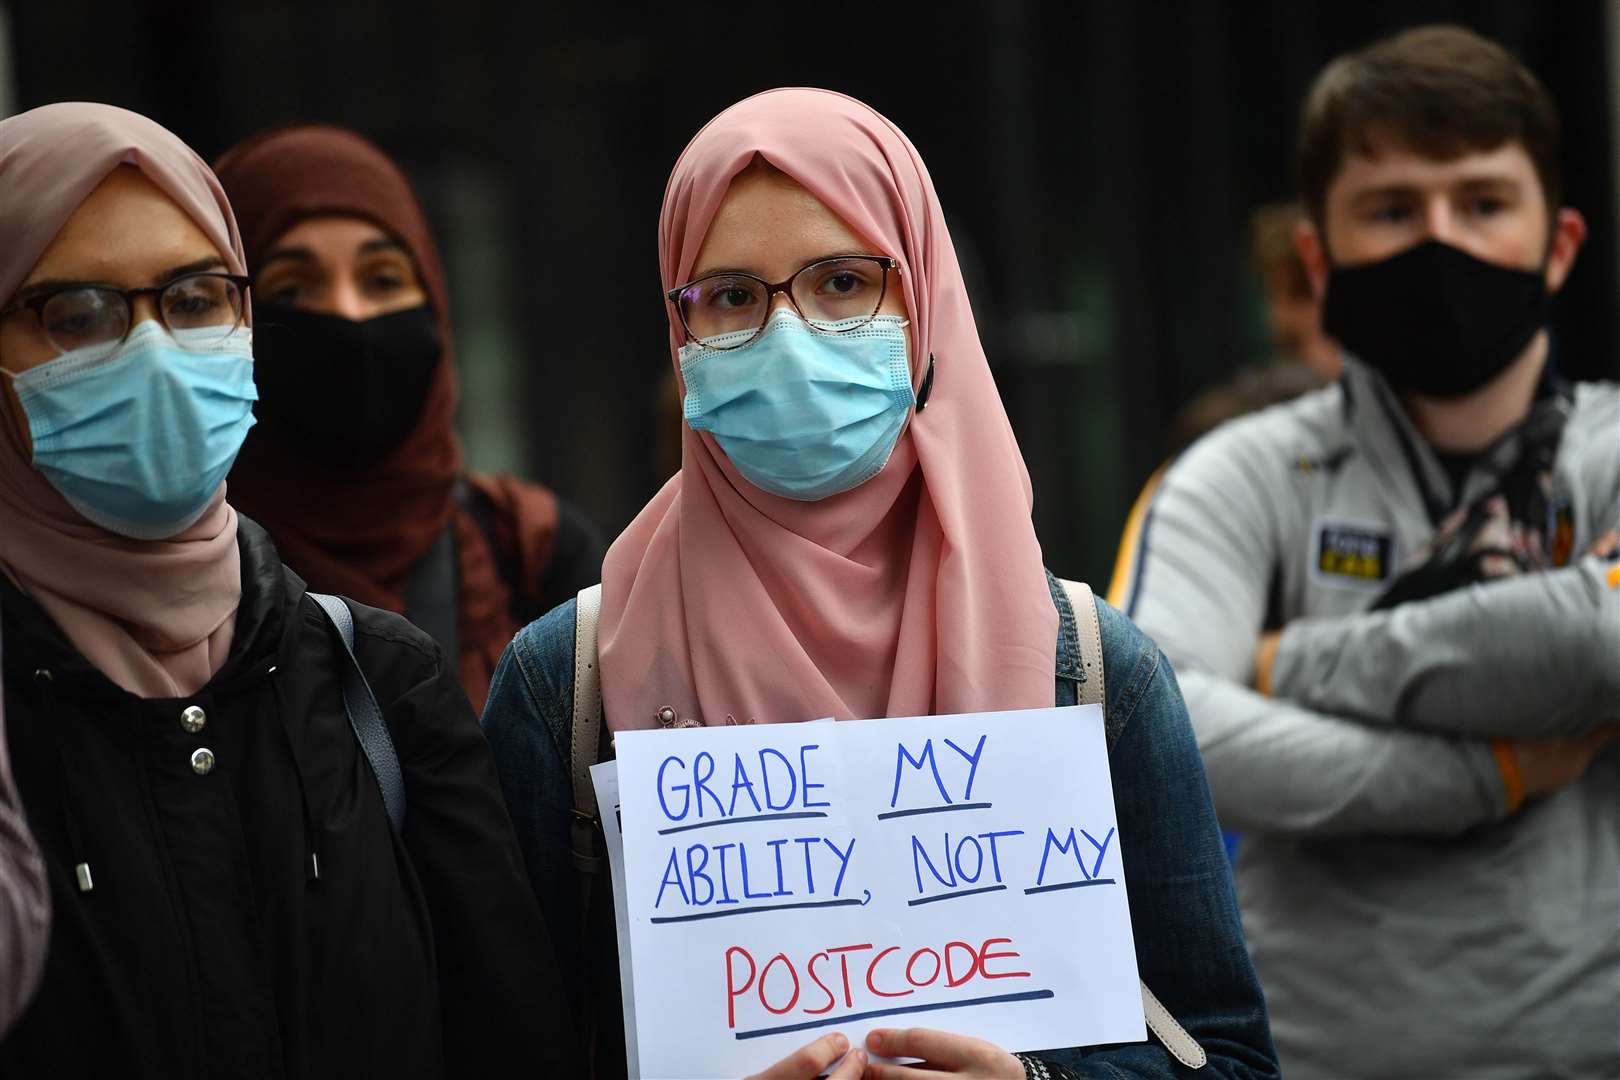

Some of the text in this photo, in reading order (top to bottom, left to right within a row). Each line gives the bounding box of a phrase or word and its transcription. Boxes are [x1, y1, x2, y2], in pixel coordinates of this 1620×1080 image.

[656, 744, 831, 822] GRADE
[890, 734, 987, 808] MY
[654, 826, 1116, 909] ABILITY, NOT MY
[725, 936, 1031, 1029] POSTCODE
